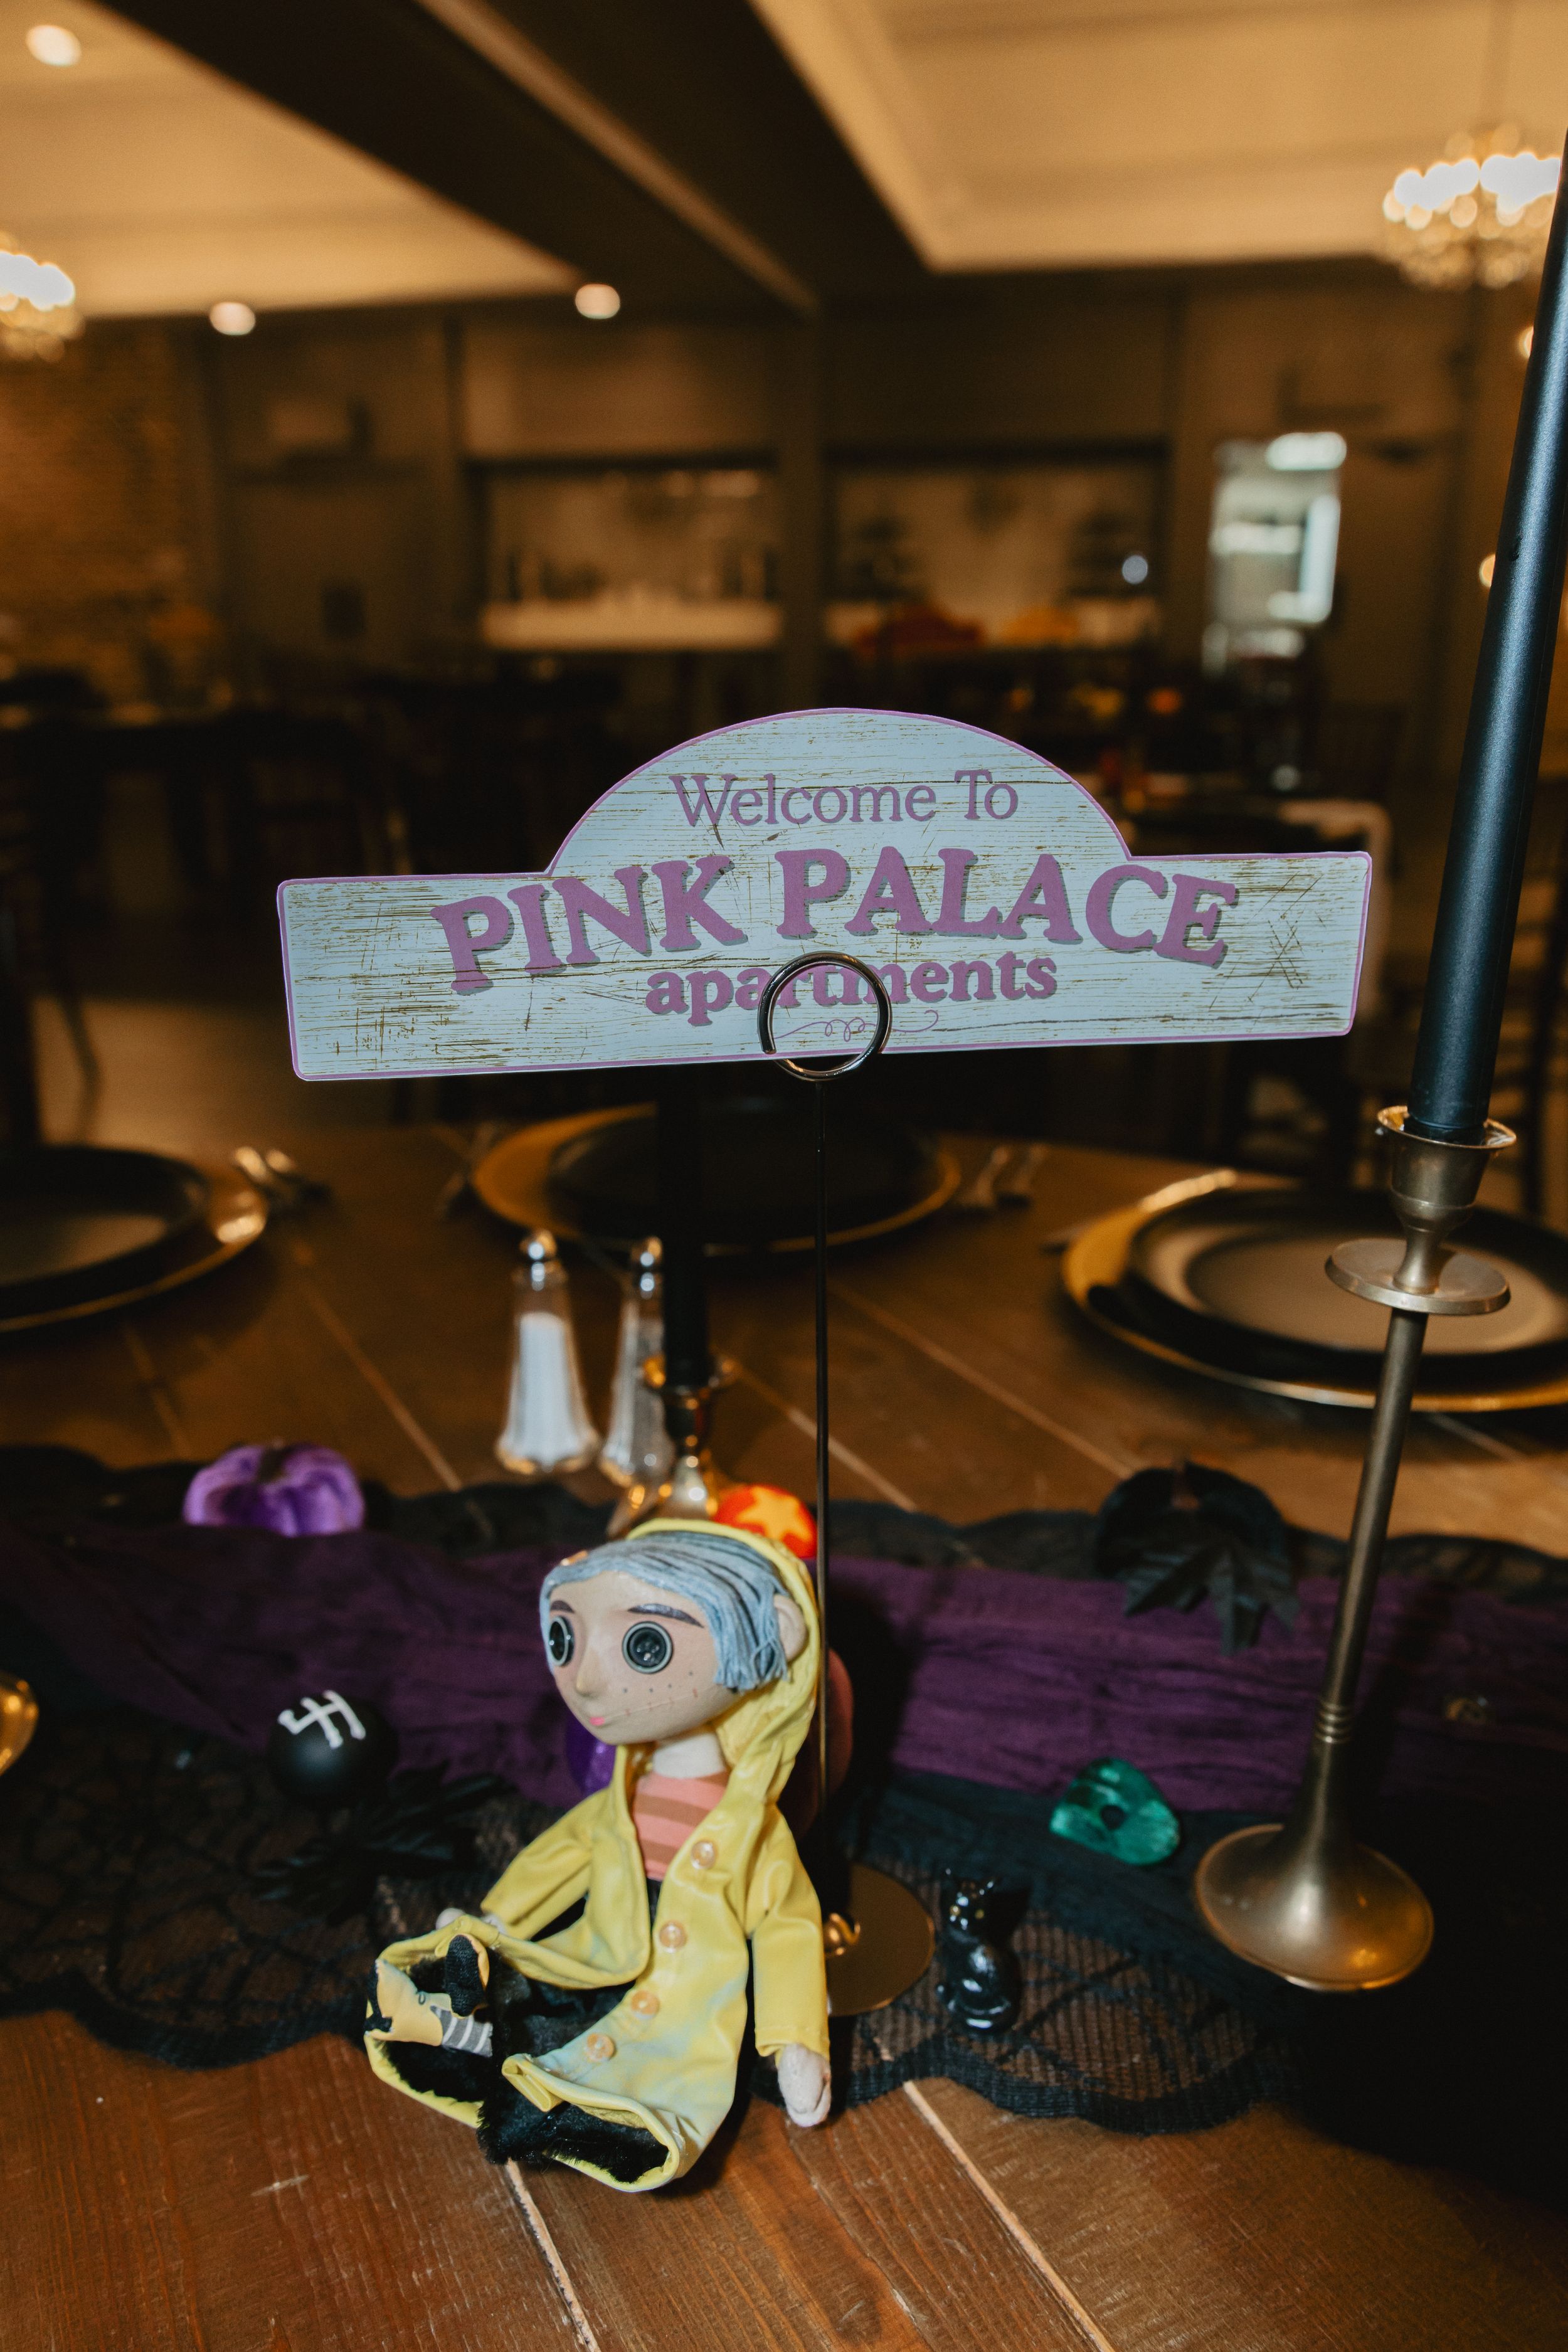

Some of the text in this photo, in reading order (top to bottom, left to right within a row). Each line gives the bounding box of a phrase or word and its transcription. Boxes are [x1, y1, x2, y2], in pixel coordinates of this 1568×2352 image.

[667, 769, 1019, 827] Welcome To
[430, 845, 1241, 996] PINK PALACE
[645, 950, 1057, 1026] apartments
